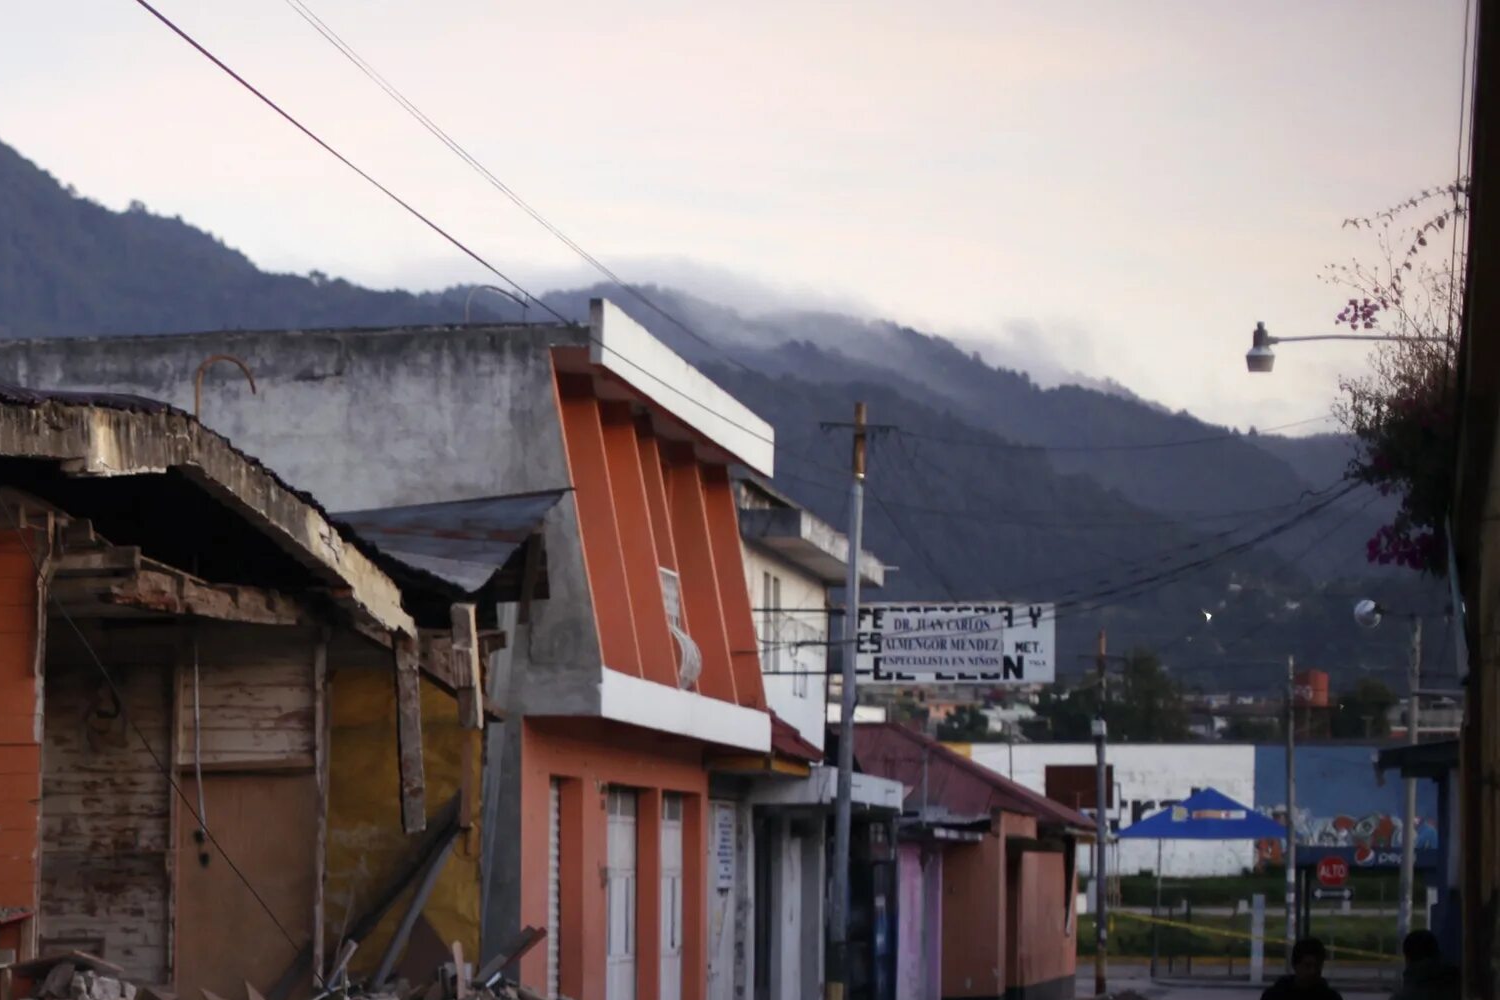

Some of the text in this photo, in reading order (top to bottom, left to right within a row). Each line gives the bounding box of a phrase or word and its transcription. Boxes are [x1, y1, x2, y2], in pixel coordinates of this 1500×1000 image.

[893, 617, 912, 631] DR.
[916, 617, 943, 631] JUAN
[946, 616, 991, 630] CARLOS
[1028, 606, 1042, 628] Y
[884, 638, 947, 651] ALMENGOR
[882, 654, 999, 666] ESPECIALISTA EN NIÑOS
[1320, 864, 1345, 878] ALTO
